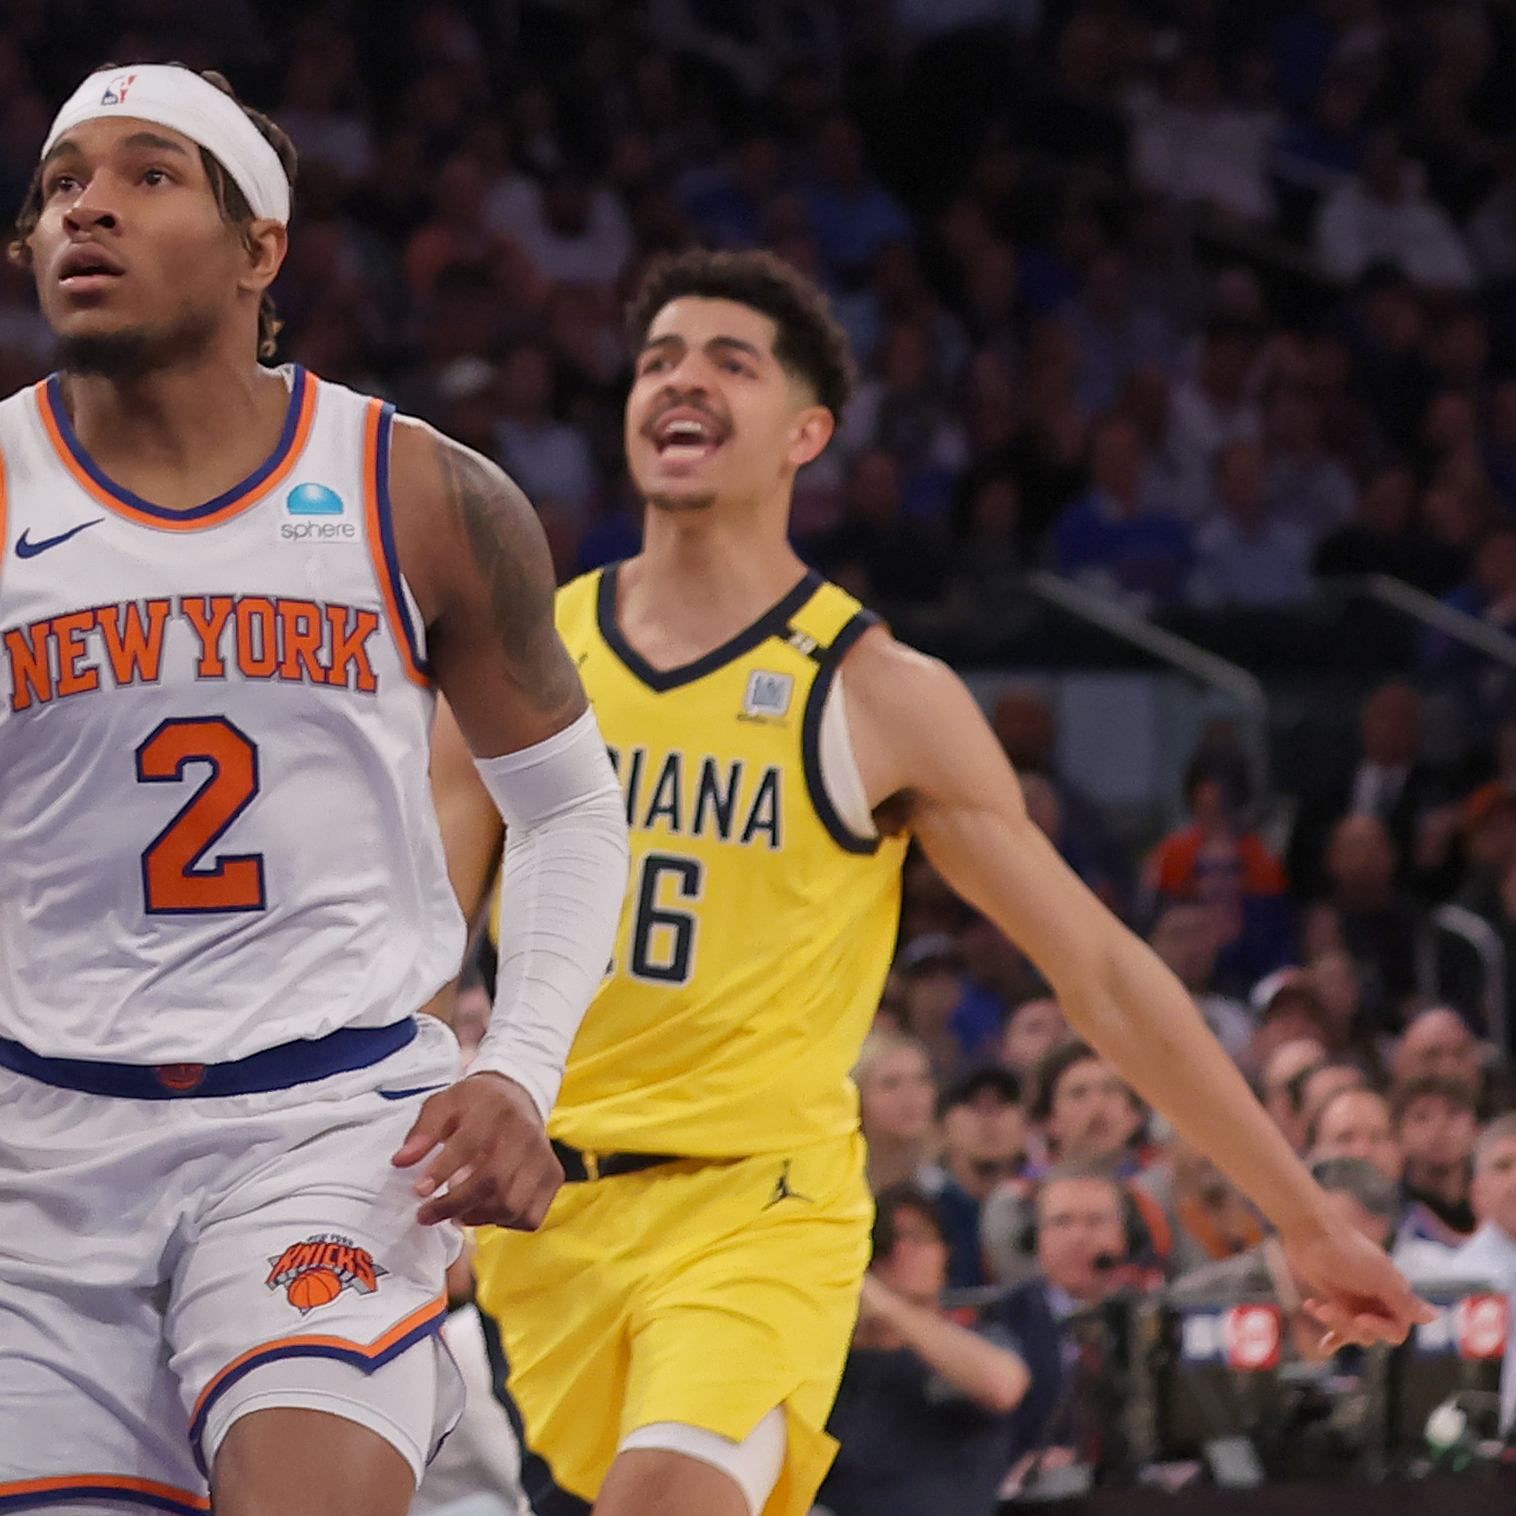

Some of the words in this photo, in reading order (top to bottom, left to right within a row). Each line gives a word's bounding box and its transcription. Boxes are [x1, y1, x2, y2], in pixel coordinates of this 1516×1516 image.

[280, 520, 356, 541] sphere
[1, 597, 171, 713] NEW
[180, 594, 380, 696] YORK
[135, 715, 266, 915] 2
[606, 743, 783, 852] IANA
[605, 851, 703, 984] 6
[266, 1241, 378, 1292] KNICKS
